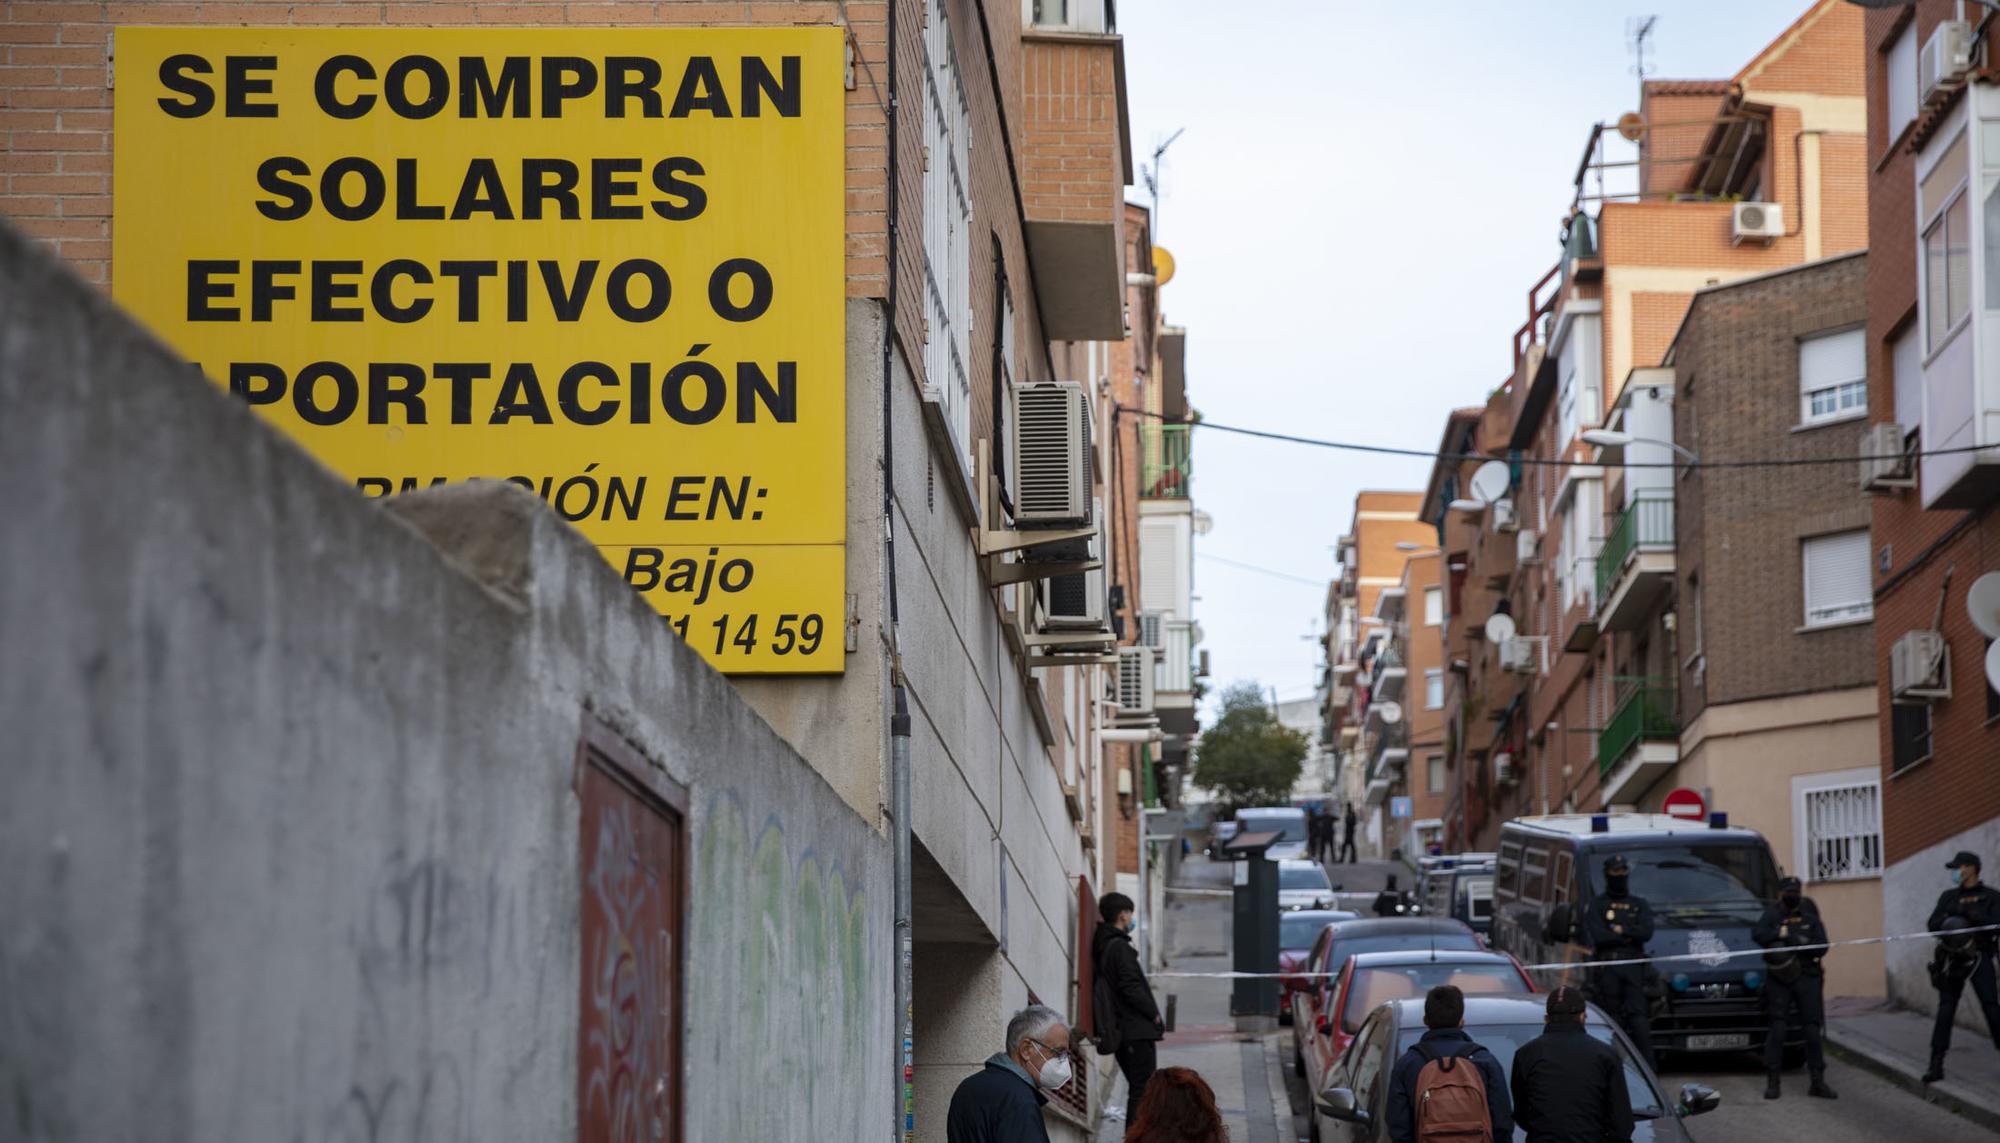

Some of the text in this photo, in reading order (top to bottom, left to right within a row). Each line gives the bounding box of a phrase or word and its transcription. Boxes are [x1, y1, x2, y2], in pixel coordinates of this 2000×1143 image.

[157, 54, 801, 119] SE COMPRAN
[255, 156, 708, 221] SOLARES
[186, 258, 774, 323] EFECTIVO O
[186, 344, 797, 426] PORTACIÓN
[664, 475, 769, 522] EN:
[623, 547, 755, 606] Bajo
[712, 613, 759, 656] 14
[771, 613, 825, 656] 59
